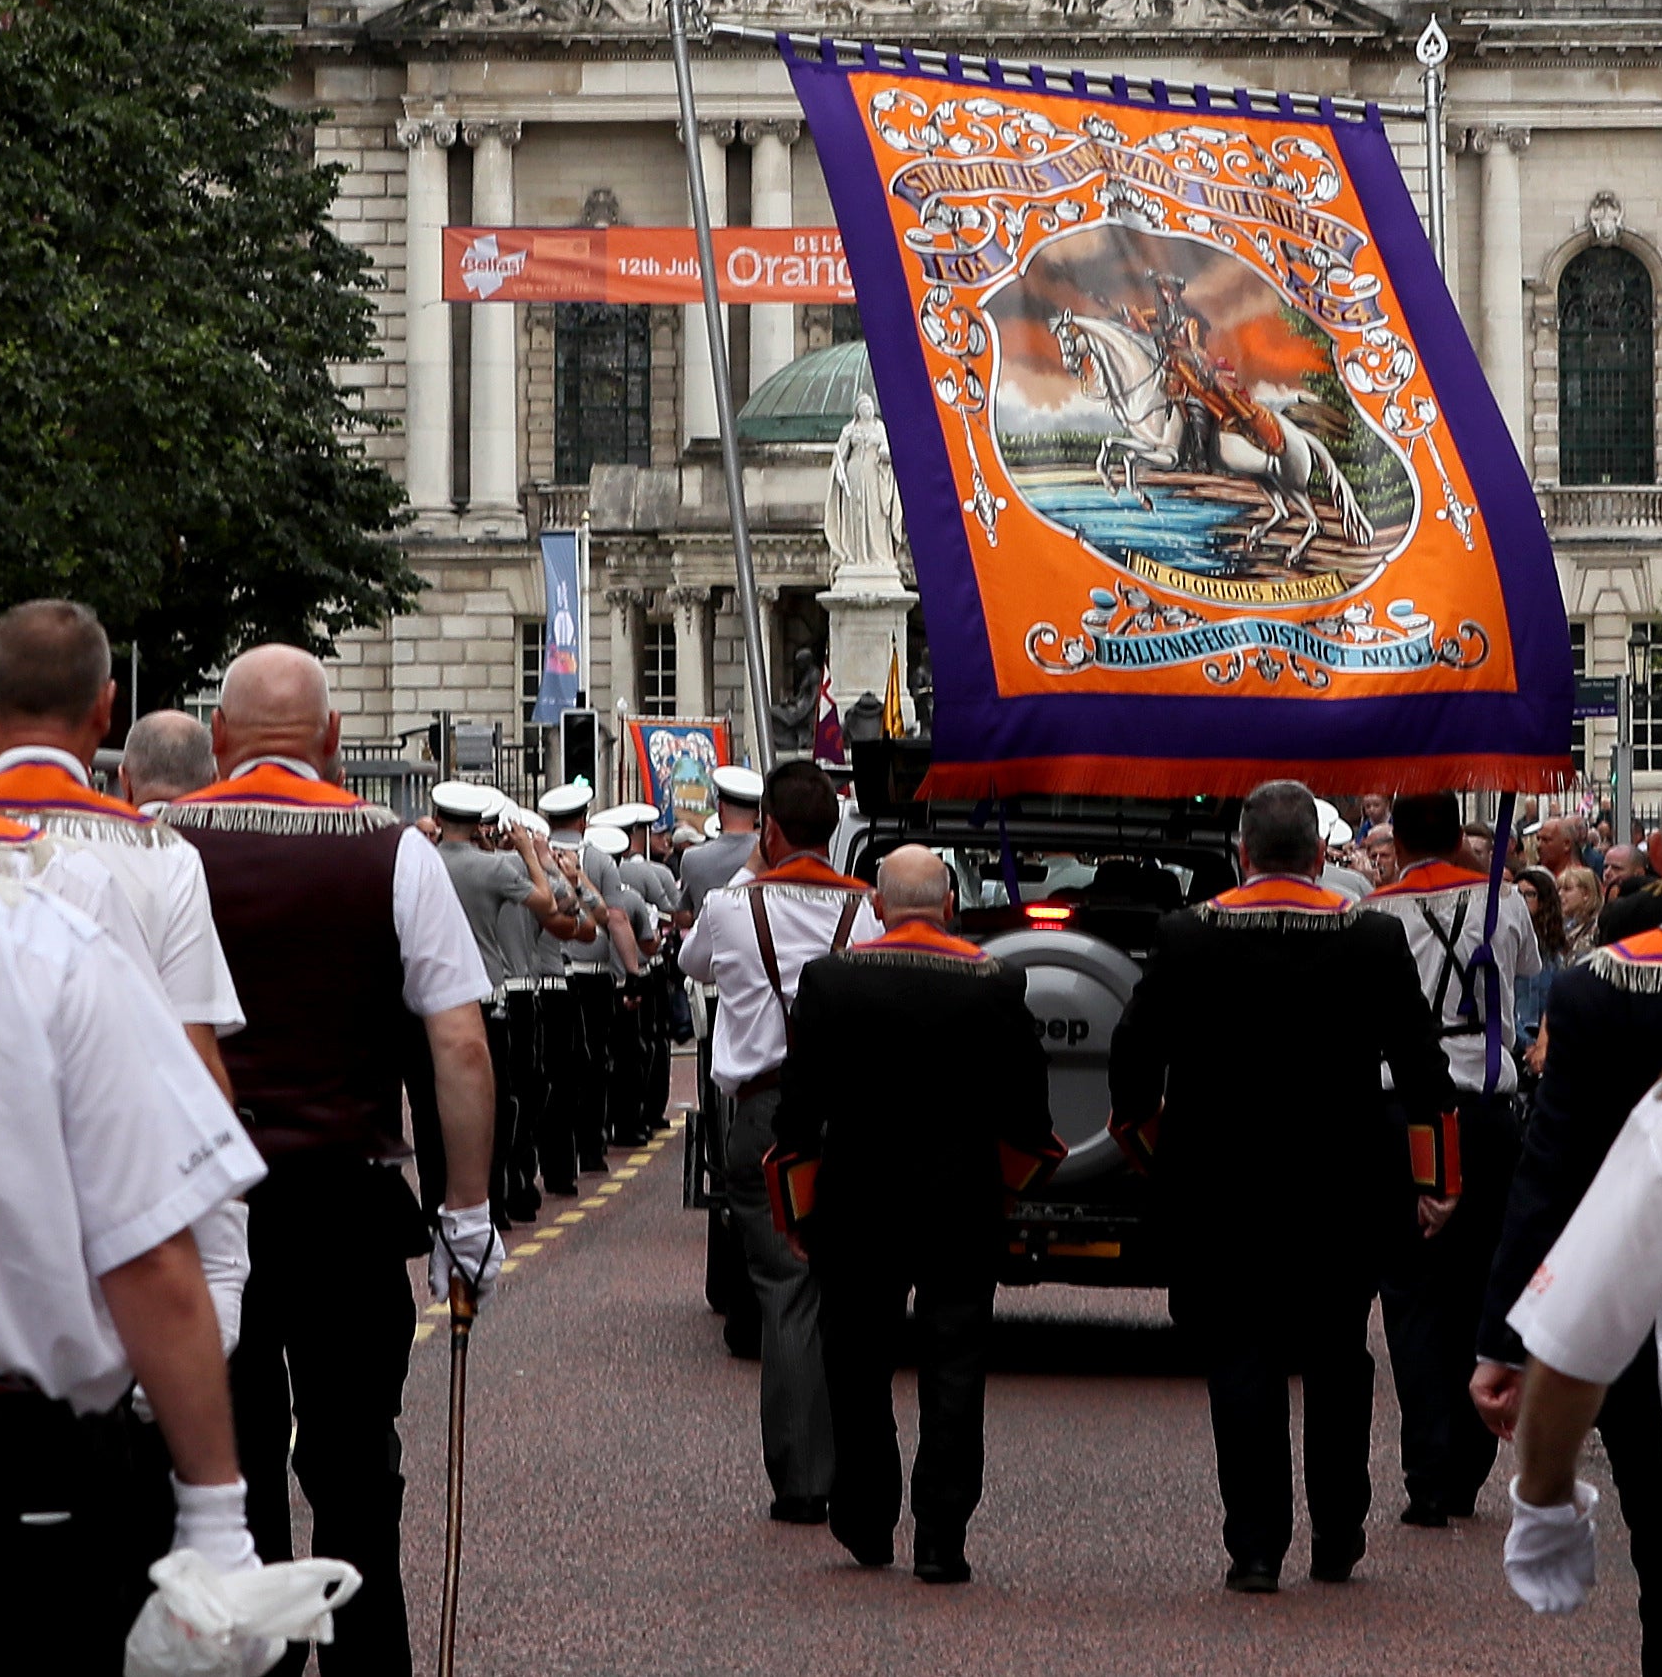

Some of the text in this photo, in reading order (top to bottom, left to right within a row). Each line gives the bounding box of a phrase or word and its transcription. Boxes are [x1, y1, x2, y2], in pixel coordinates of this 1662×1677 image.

[902, 141, 1350, 251] STRANMILLIS TEMPRANCE VOLUNTEERS
[617, 256, 660, 277] 12th
[664, 256, 702, 280] July
[1297, 287, 1372, 324] 454
[1140, 557, 1339, 603] IN GLORIOUS MEMORY
[1106, 625, 1249, 664] BALLYNAFEIGH
[1256, 622, 1348, 666] DISTRICT
